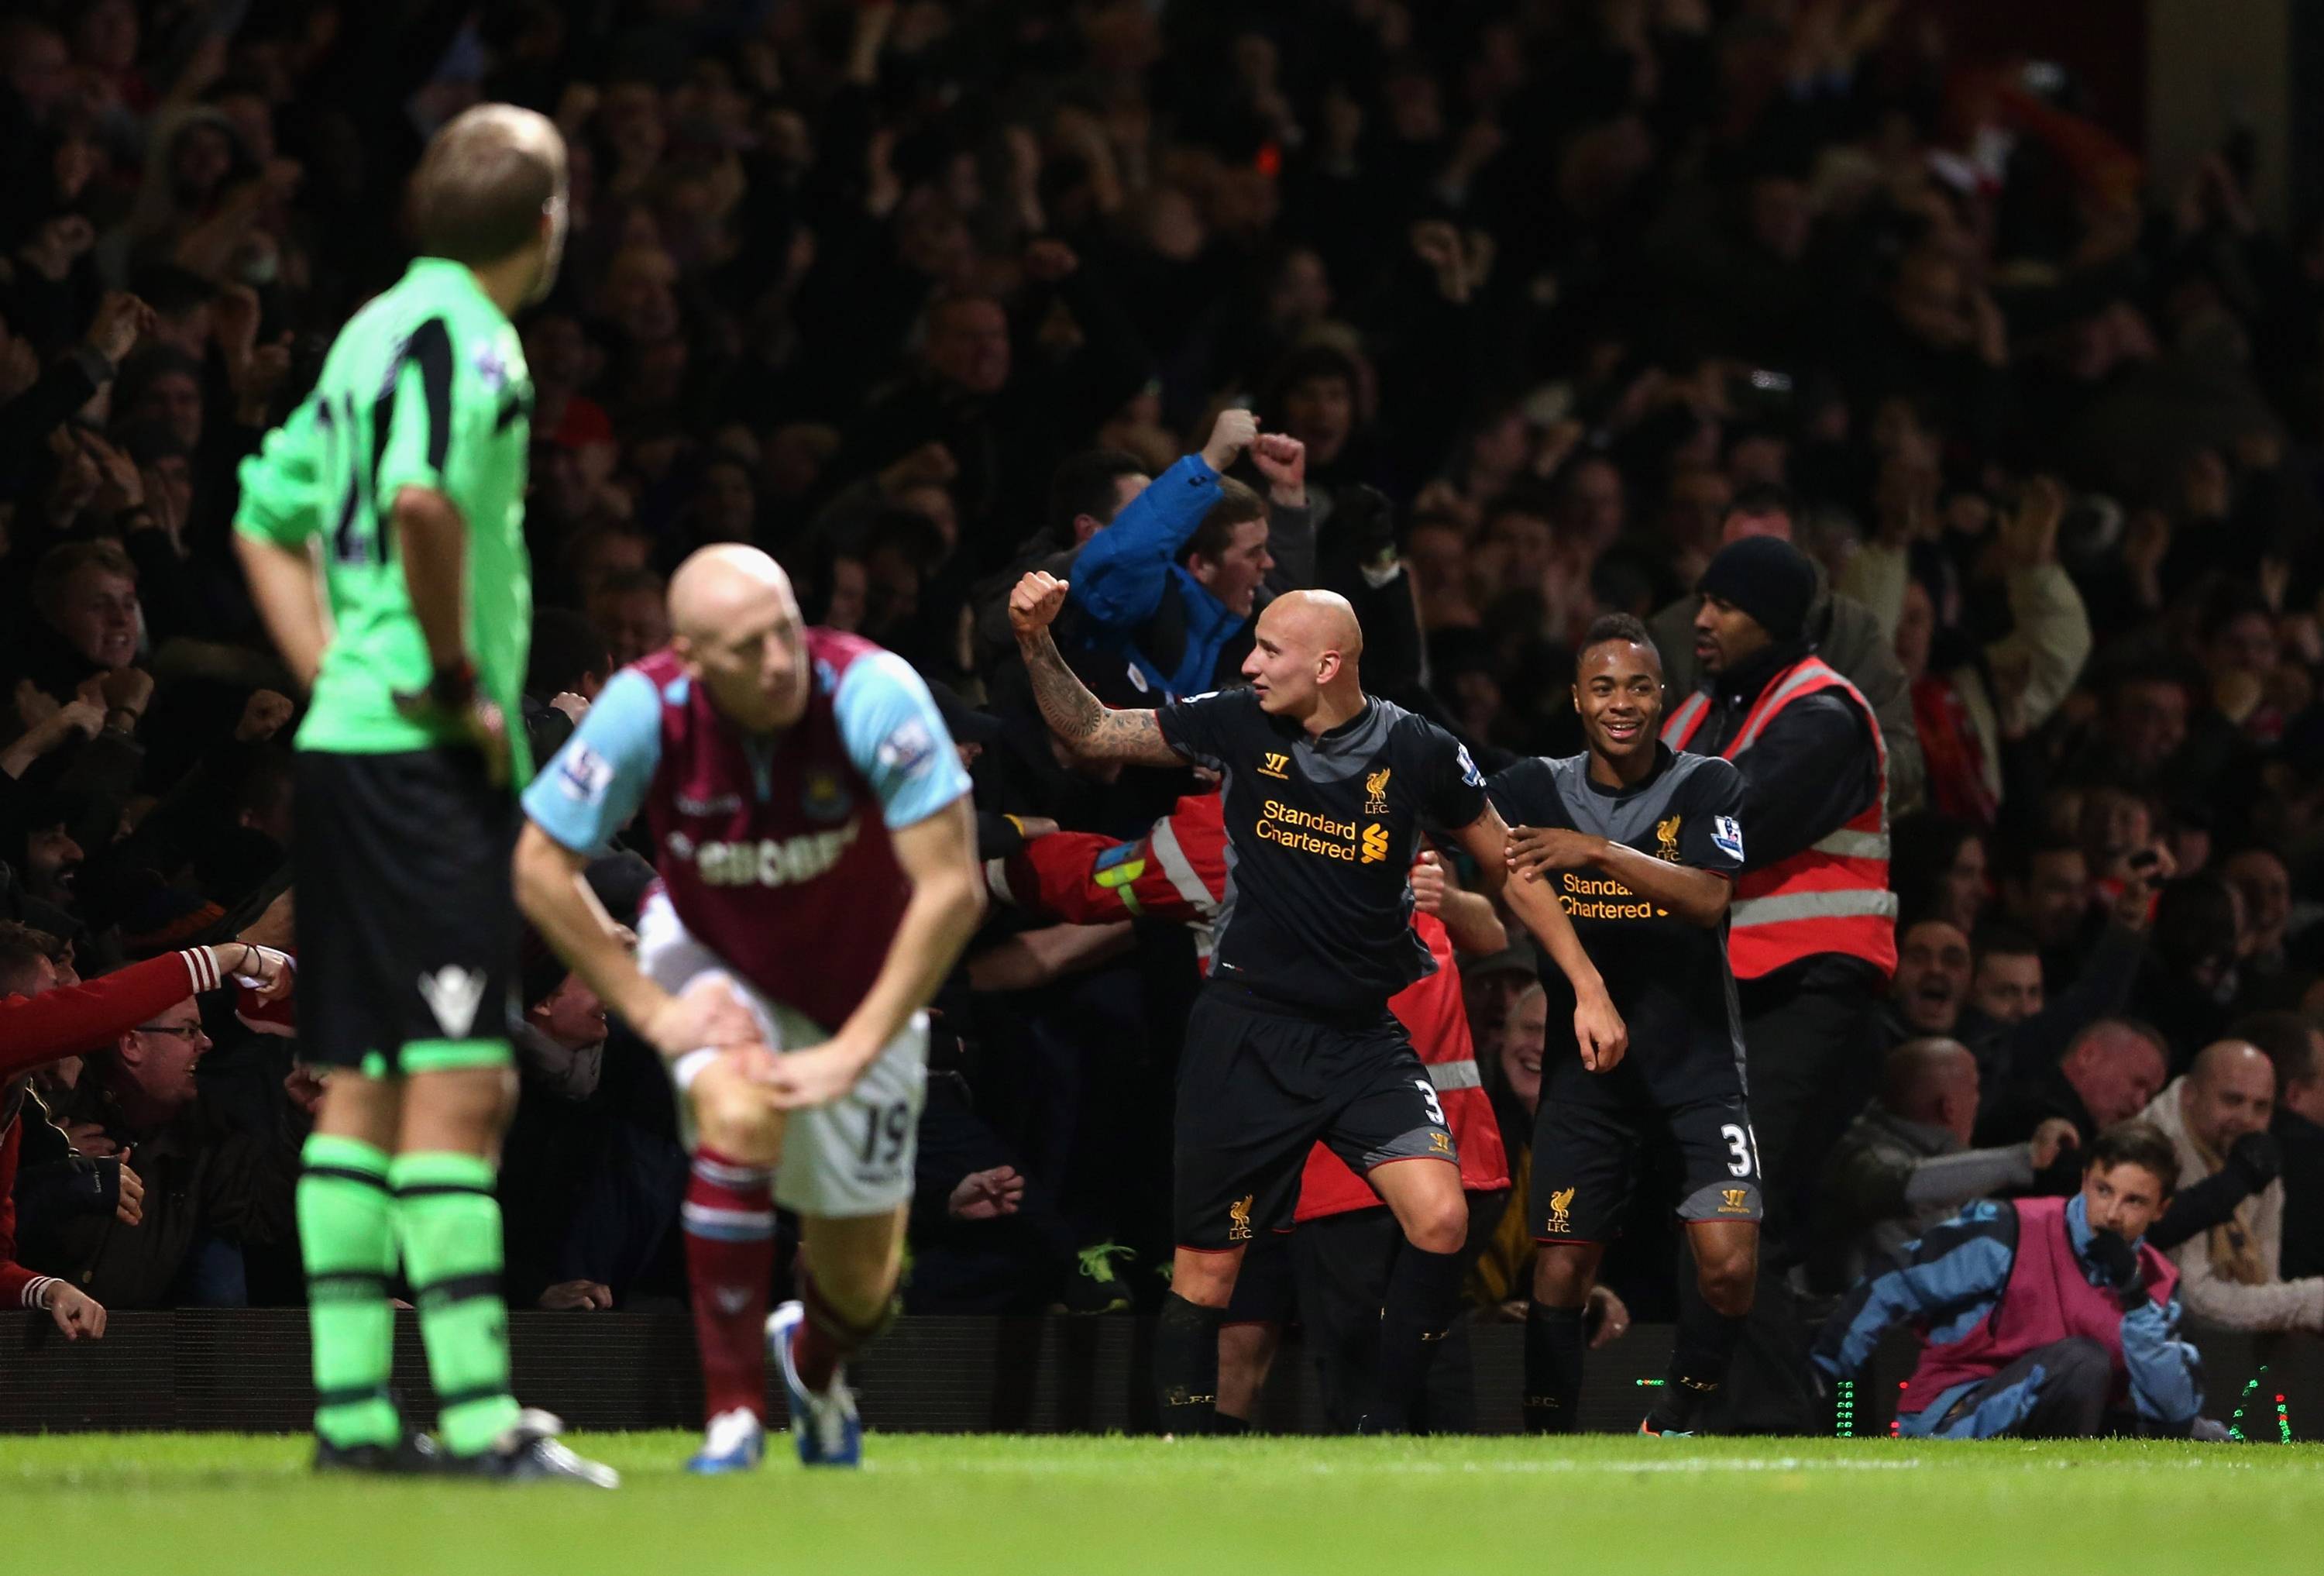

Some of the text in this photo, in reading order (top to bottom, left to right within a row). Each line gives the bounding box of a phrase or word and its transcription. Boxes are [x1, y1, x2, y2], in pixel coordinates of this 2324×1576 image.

[1256, 819, 1356, 862] Chartered
[1263, 799, 1356, 841] Standard
[1563, 873, 1633, 896] Standa
[1559, 895, 1652, 919] Chartered
[861, 1099, 908, 1163] 19
